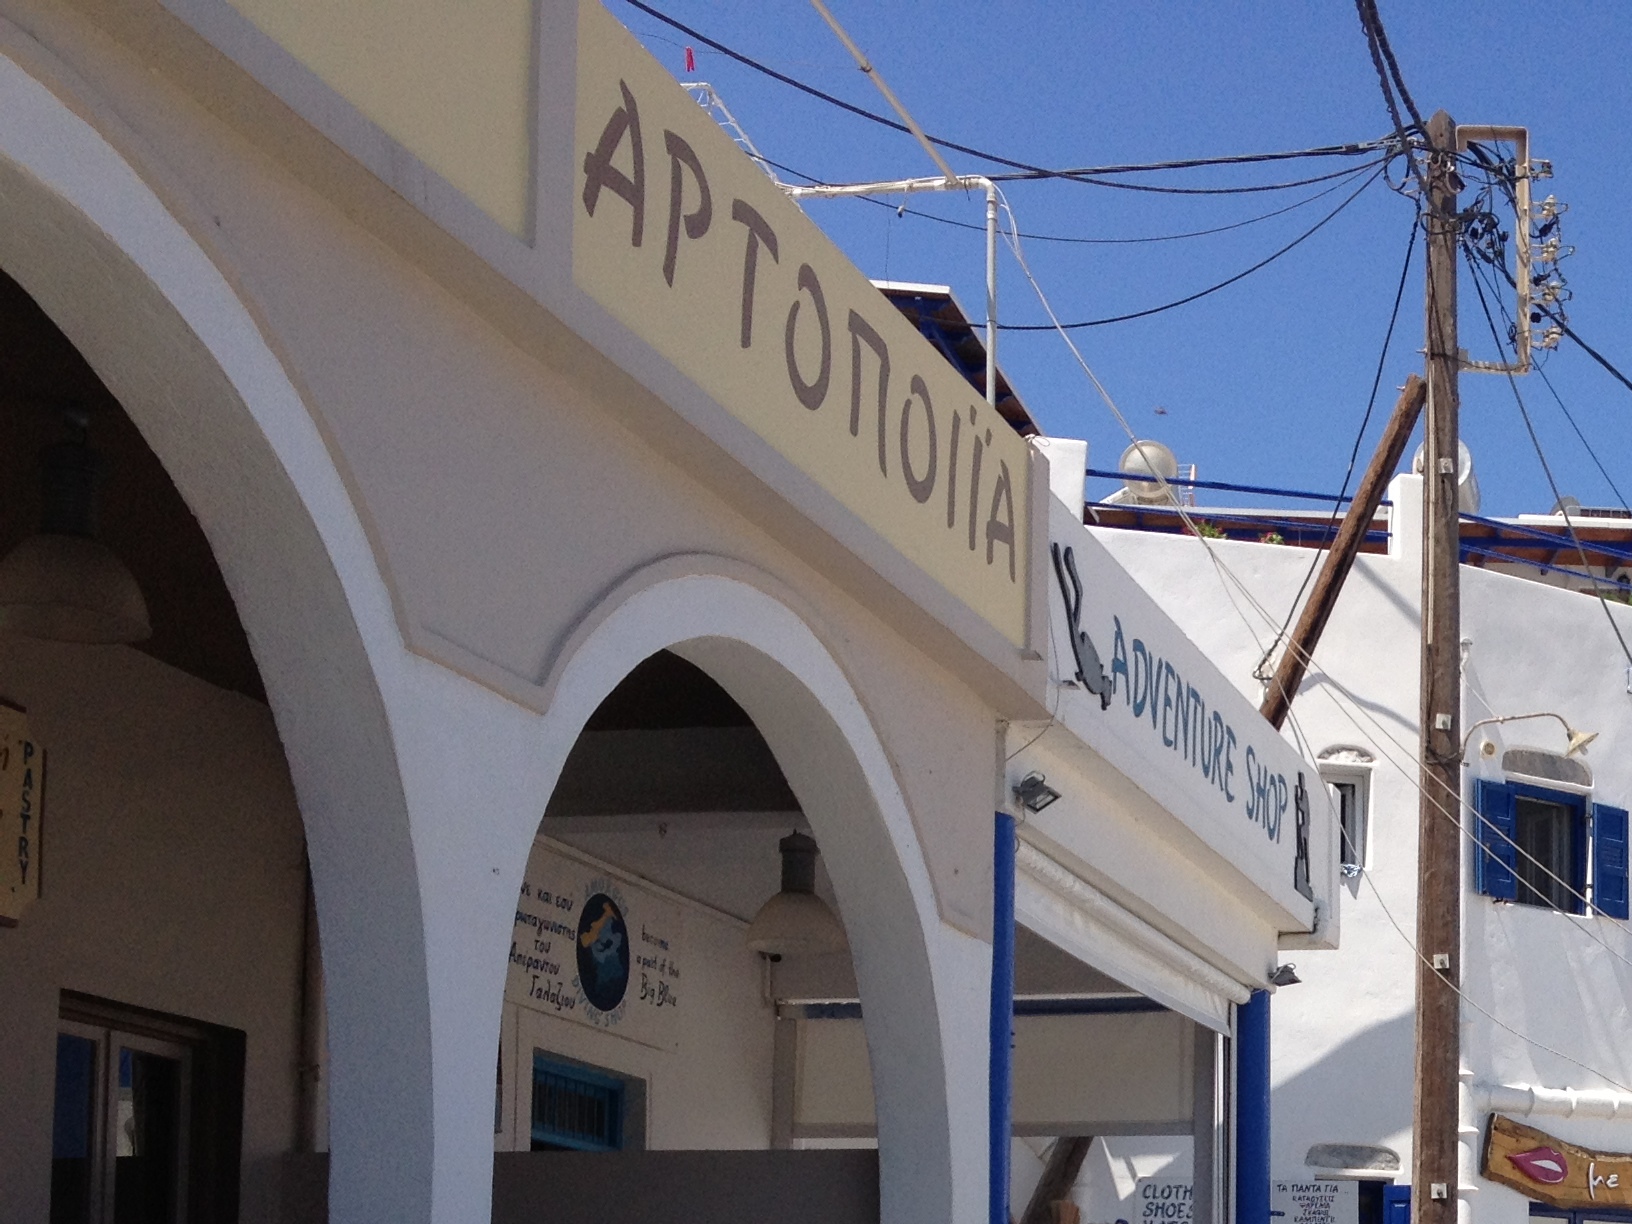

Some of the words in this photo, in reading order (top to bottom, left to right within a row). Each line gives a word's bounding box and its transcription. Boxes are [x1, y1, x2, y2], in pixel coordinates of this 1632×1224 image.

[1111, 614, 1237, 803] ADVENTURE
[1246, 745, 1288, 844] SHOP
[18, 740, 34, 885] PASTRY
[640, 972, 655, 1005] Big
[656, 980, 677, 1008] Blue
[1276, 1184, 1288, 1193] ΤΑ
[1291, 1184, 1321, 1194] ΠΑΝΤΑ
[1588, 1161, 1619, 1200] με
